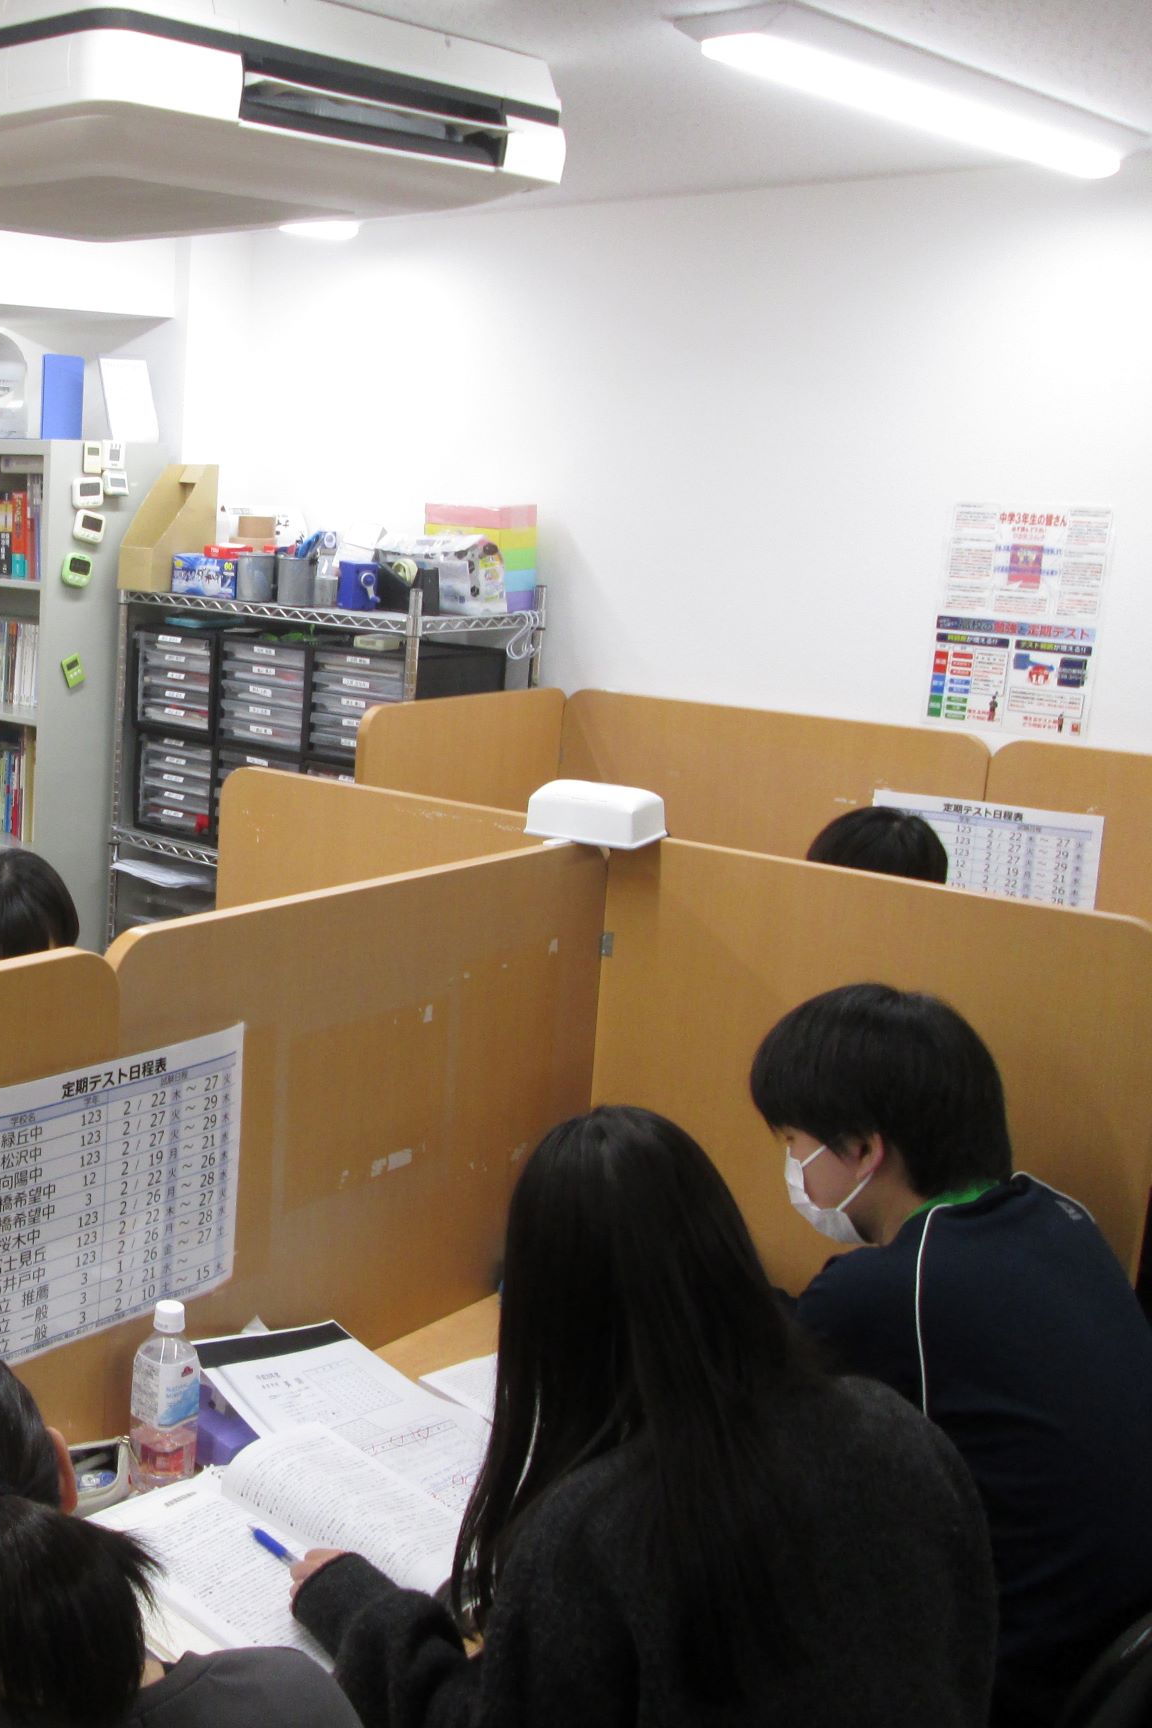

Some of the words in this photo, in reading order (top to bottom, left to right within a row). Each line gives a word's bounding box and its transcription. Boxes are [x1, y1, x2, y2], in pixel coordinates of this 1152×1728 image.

[943, 803, 1023, 822] 定期テスト日程表
[62, 1057, 167, 1099] 定期テスト日程表
[1, 1125, 42, 1149] 緑丘中
[82, 1110, 102, 1126] 123
[124, 1101, 130, 1115] 2
[152, 1091, 166, 1107] 22
[204, 1075, 218, 1092] 27
[1, 1147, 41, 1170] 松沢中
[81, 1130, 101, 1147] 123
[123, 1121, 130, 1136] 2
[150, 1111, 165, 1128] 27
[204, 1094, 218, 1111] 29
[0, 1167, 42, 1192] 向陽中
[80, 1151, 100, 1168] 123
[122, 1141, 129, 1156] 2
[150, 1131, 164, 1147] 27
[203, 1114, 217, 1130] 29
[83, 1172, 96, 1187] 12
[121, 1161, 128, 1176] 2
[150, 1150, 163, 1166] 19
[202, 1134, 215, 1150] 21
[85, 1193, 92, 1206] 3
[120, 1181, 128, 1196] 2
[148, 1170, 162, 1186] 22
[201, 1152, 216, 1169] 26
[78, 1211, 98, 1228] 123
[120, 1201, 127, 1215] 2
[147, 1189, 160, 1206] 26
[200, 1172, 214, 1188] 28
[78, 1231, 97, 1248] 123
[119, 1221, 126, 1234] 2
[145, 1209, 159, 1225] 22
[200, 1191, 213, 1207] 27
[76, 1251, 96, 1268] 123
[118, 1240, 125, 1254] 2
[144, 1227, 158, 1244] 26
[198, 1209, 212, 1225] 28
[21, 1304, 48, 1322] 一般
[80, 1292, 87, 1304] 3
[115, 1279, 122, 1293] 2
[142, 1267, 154, 1283] 21
[22, 1284, 49, 1308] 推薦
[81, 1273, 87, 1285] 3
[119, 1260, 122, 1273] 1
[144, 1246, 157, 1263] 26
[197, 1228, 212, 1244] 27
[20, 1324, 47, 1342] 一般
[79, 1312, 86, 1324] 3
[115, 1298, 122, 1312] 2
[142, 1285, 155, 1300] 10
[197, 1266, 209, 1281] 15
